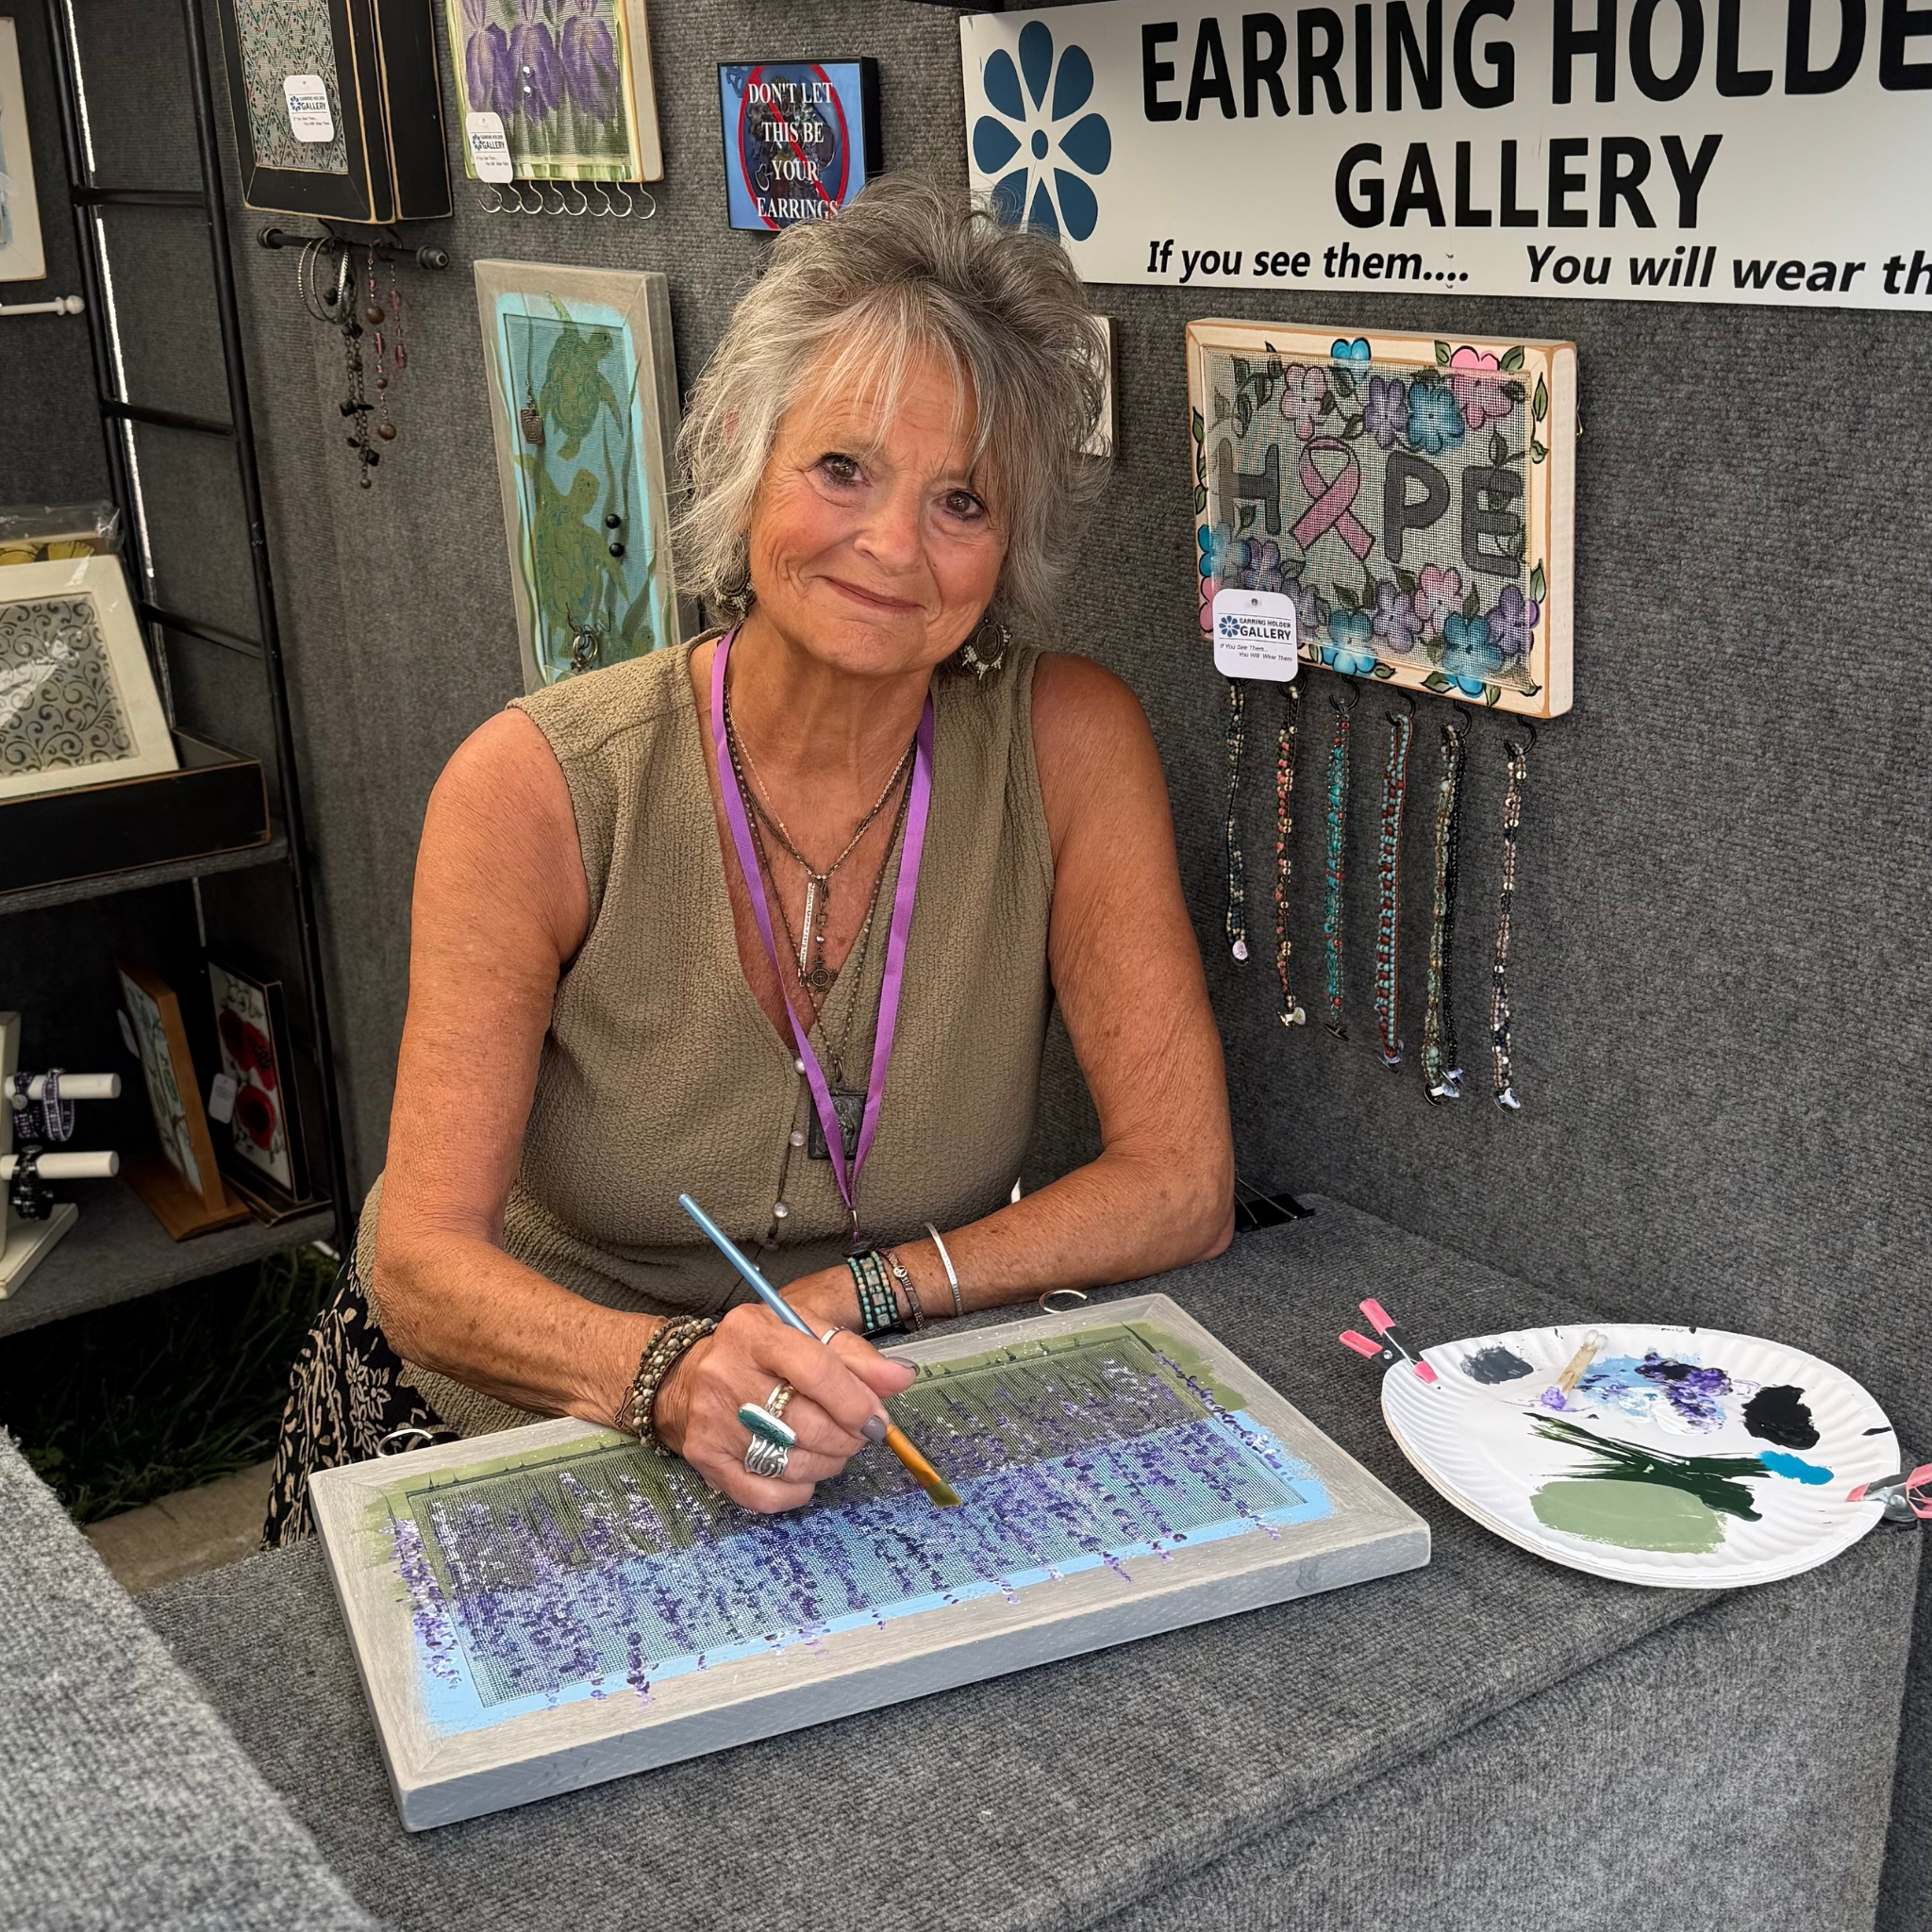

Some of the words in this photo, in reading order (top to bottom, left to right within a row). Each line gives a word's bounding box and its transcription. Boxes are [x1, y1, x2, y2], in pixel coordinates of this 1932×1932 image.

[1141, 0, 1515, 122] EARRING
[748, 82, 797, 104] DON'T
[802, 82, 833, 104] LET
[761, 122, 799, 143] THIS
[803, 122, 824, 143] BE
[771, 159, 819, 181] YOUR
[1335, 134, 1724, 228] GALLERY
[757, 197, 839, 220] EARRINGS
[1147, 239, 1174, 274] If
[1178, 250, 1242, 284] you
[1253, 249, 1310, 278] see
[1323, 242, 1469, 282] them....
[1526, 244, 1611, 284] You
[1629, 245, 1717, 288] will
[1732, 258, 1866, 293] wear
[1240, 618, 1266, 626] EARRING
[1240, 625, 1291, 640] GALLERY
